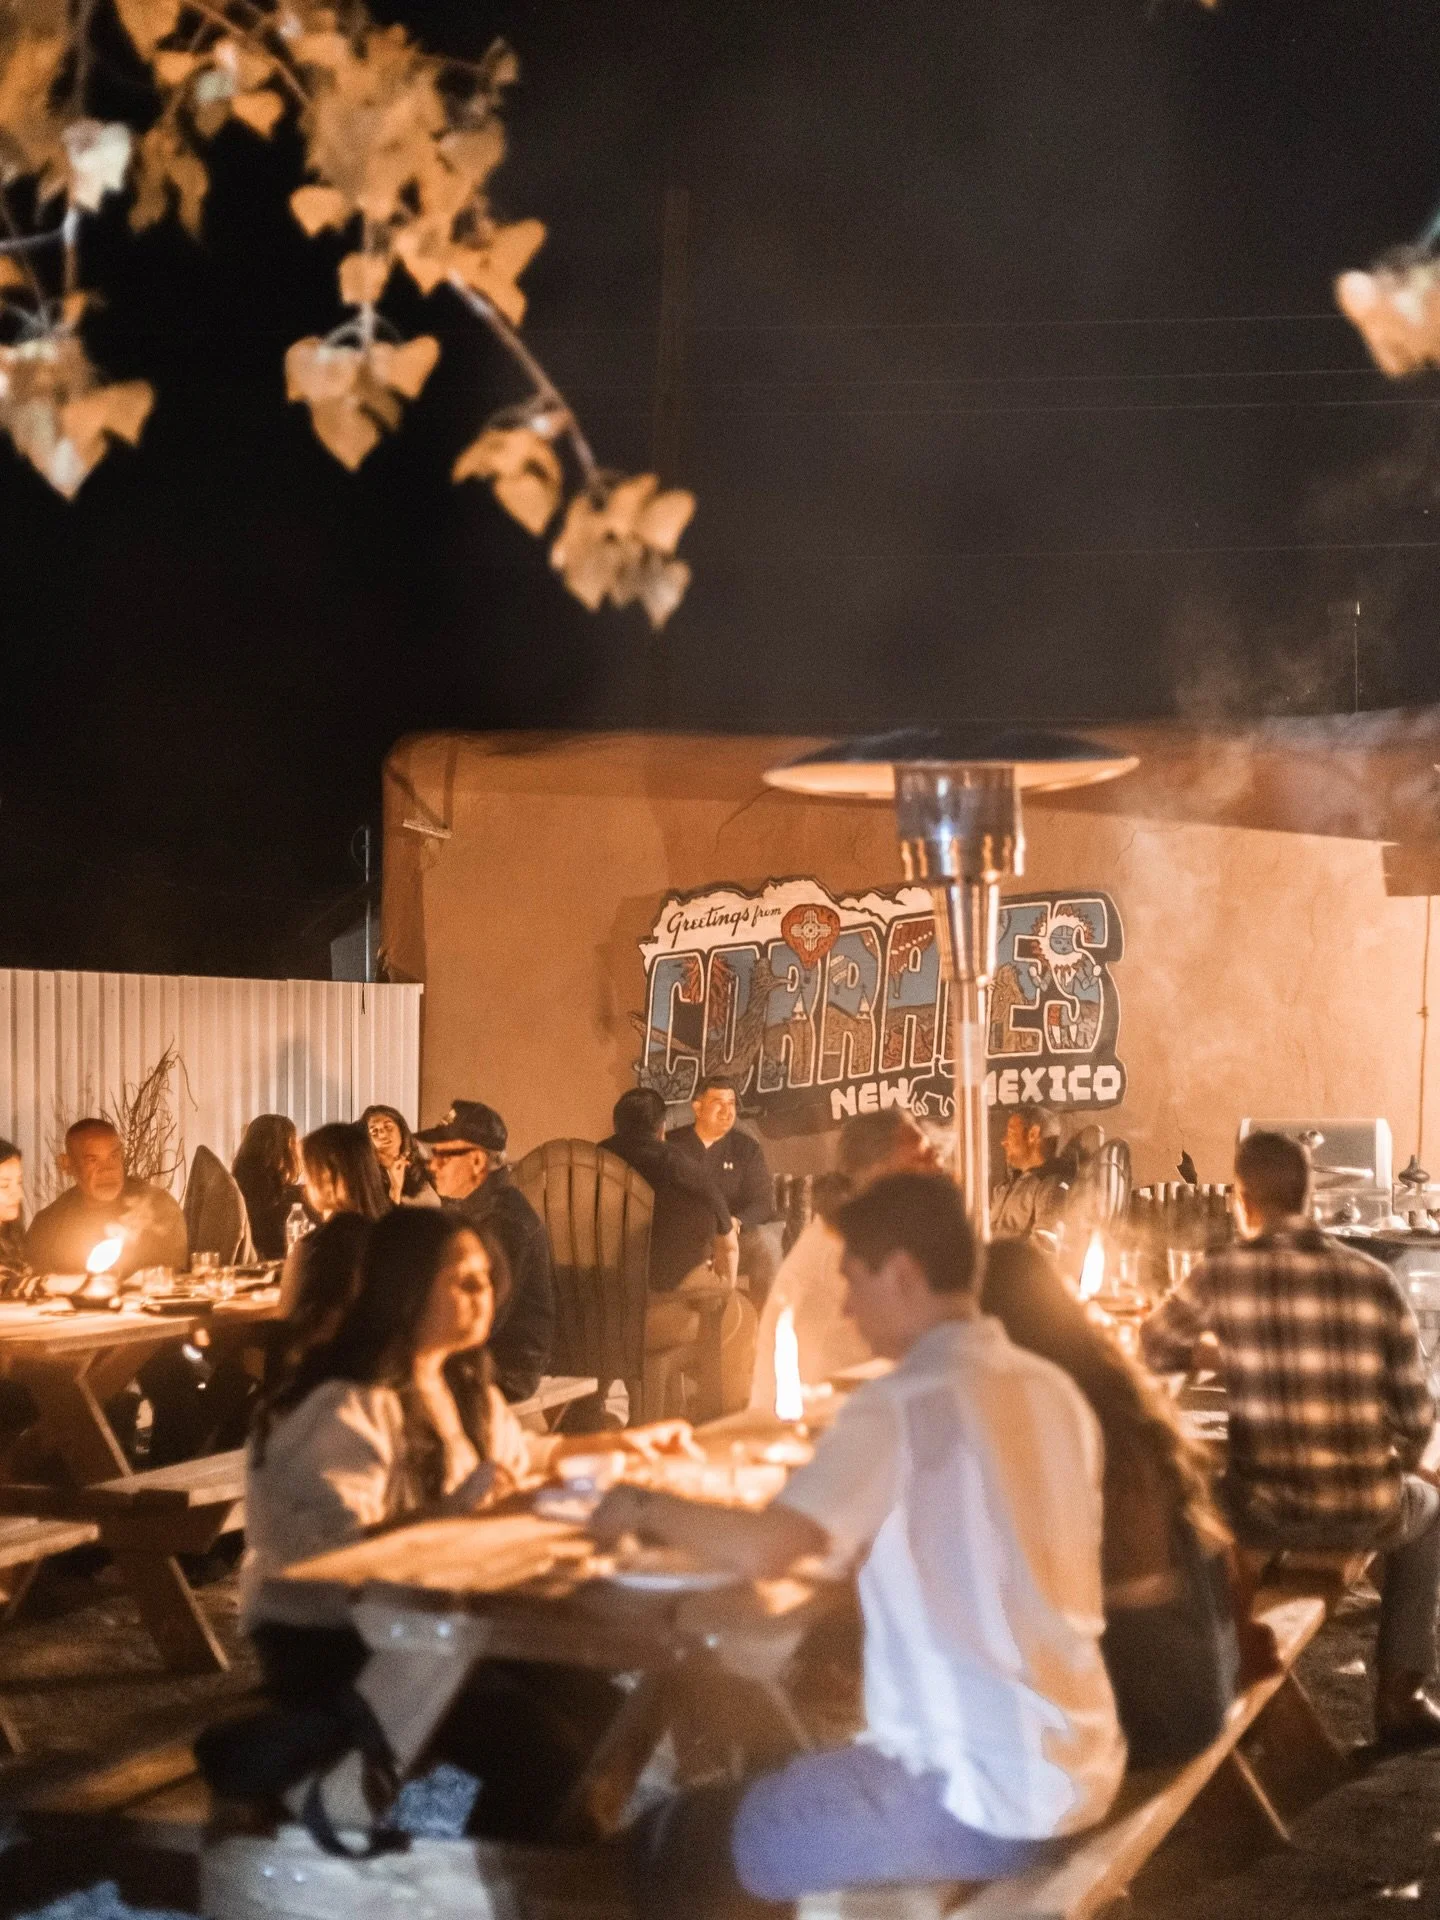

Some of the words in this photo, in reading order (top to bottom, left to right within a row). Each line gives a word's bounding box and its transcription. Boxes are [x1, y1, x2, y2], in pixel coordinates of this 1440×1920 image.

[666, 905, 749, 949] Greetings
[752, 905, 782, 928] from
[642, 899, 1108, 1104] CORRAES
[830, 1077, 910, 1120] NEW
